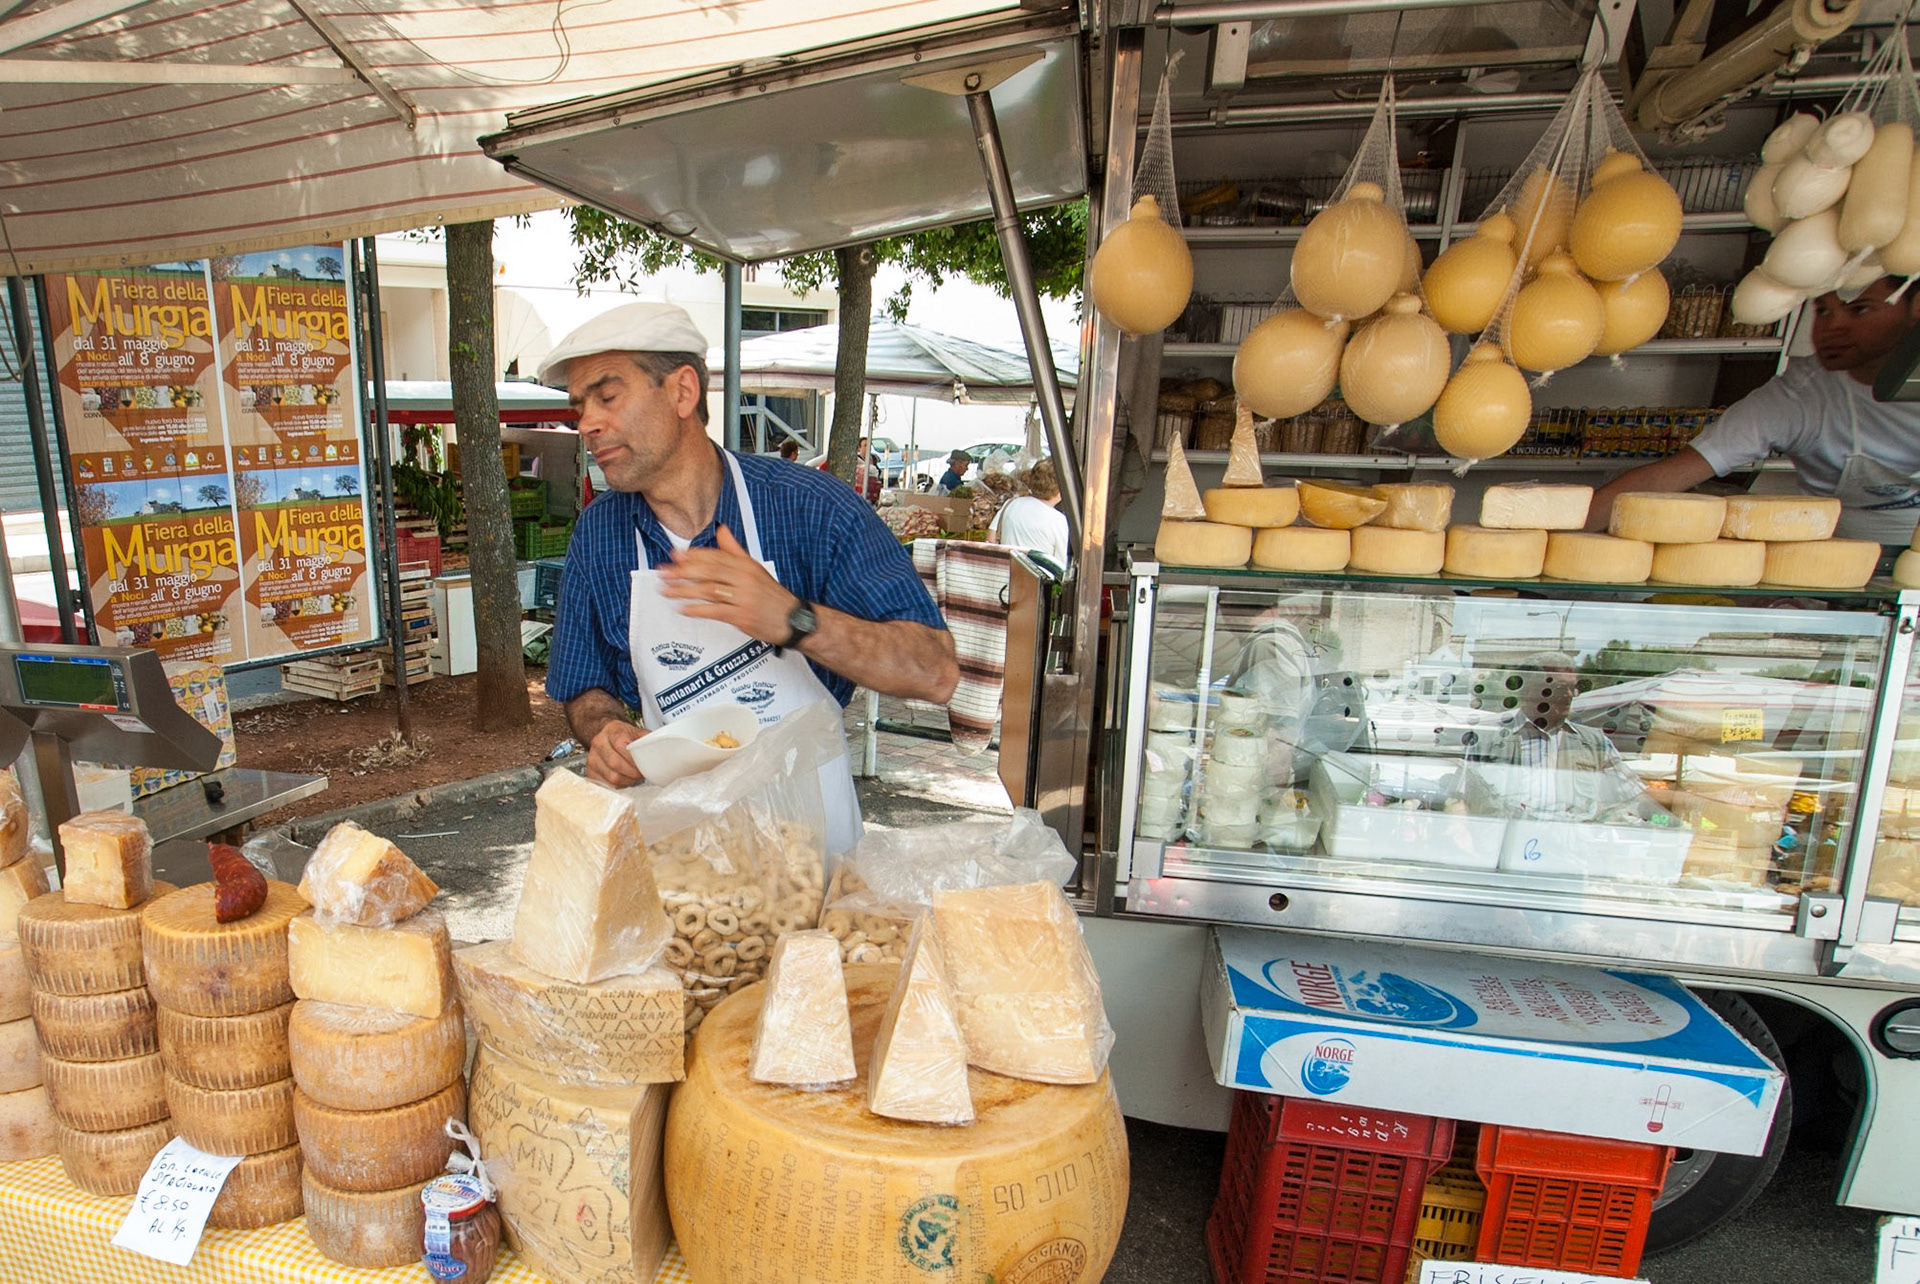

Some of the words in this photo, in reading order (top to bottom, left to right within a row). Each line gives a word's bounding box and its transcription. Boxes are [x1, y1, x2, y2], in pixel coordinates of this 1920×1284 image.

[111, 278, 159, 300] Fiera
[164, 281, 209, 301] della
[267, 286, 307, 306] Fiera
[311, 287, 347, 308] della
[66, 276, 212, 348] Murgia
[231, 284, 350, 351] Murgia
[73, 336, 95, 351] dal
[101, 336, 117, 351] 31
[123, 336, 169, 354] maggio
[235, 339, 253, 352] dal
[257, 338, 270, 352] 31
[275, 341, 314, 355] maggio
[87, 351, 111, 361] Noci
[118, 351, 135, 366] all'
[140, 352, 150, 366] 8
[155, 353, 195, 369] giugno
[246, 352, 266, 362] Noci
[272, 352, 285, 366] all'
[290, 353, 298, 366] 8
[302, 353, 335, 369] giugno
[290, 508, 325, 526] Fiera
[329, 504, 362, 524] della
[144, 523, 188, 542] Fiera
[193, 516, 235, 536] della
[254, 509, 365, 562] Murgia
[102, 524, 238, 581] Murgia
[257, 559, 274, 572] dal
[279, 557, 291, 570] 31
[296, 554, 332, 568] maggio
[108, 579, 129, 593] dal
[134, 577, 149, 590] 31
[155, 572, 198, 588] maggio
[268, 572, 286, 580] Noci
[291, 568, 305, 581] all'
[309, 568, 317, 579] 8
[321, 566, 352, 580] giugno
[121, 591, 144, 601] Noci
[151, 588, 166, 602] all'
[172, 587, 180, 599] 8
[185, 584, 222, 600] giugno
[657, 679, 706, 709] Montanari
[705, 670, 716, 683] &
[713, 653, 749, 677] Gruzza
[672, 704, 691, 718] BURRO
[696, 684, 729, 704] FORMAGGI
[733, 658, 769, 682] PROSCIUTTI
[1290, 960, 1345, 1010] NORGE
[575, 1010, 618, 1020] PADANO
[1315, 1045, 1354, 1061] NORGE
[140, 1189, 157, 1214] €
[153, 1195, 189, 1212] 8.50
[148, 1218, 164, 1234] AL
